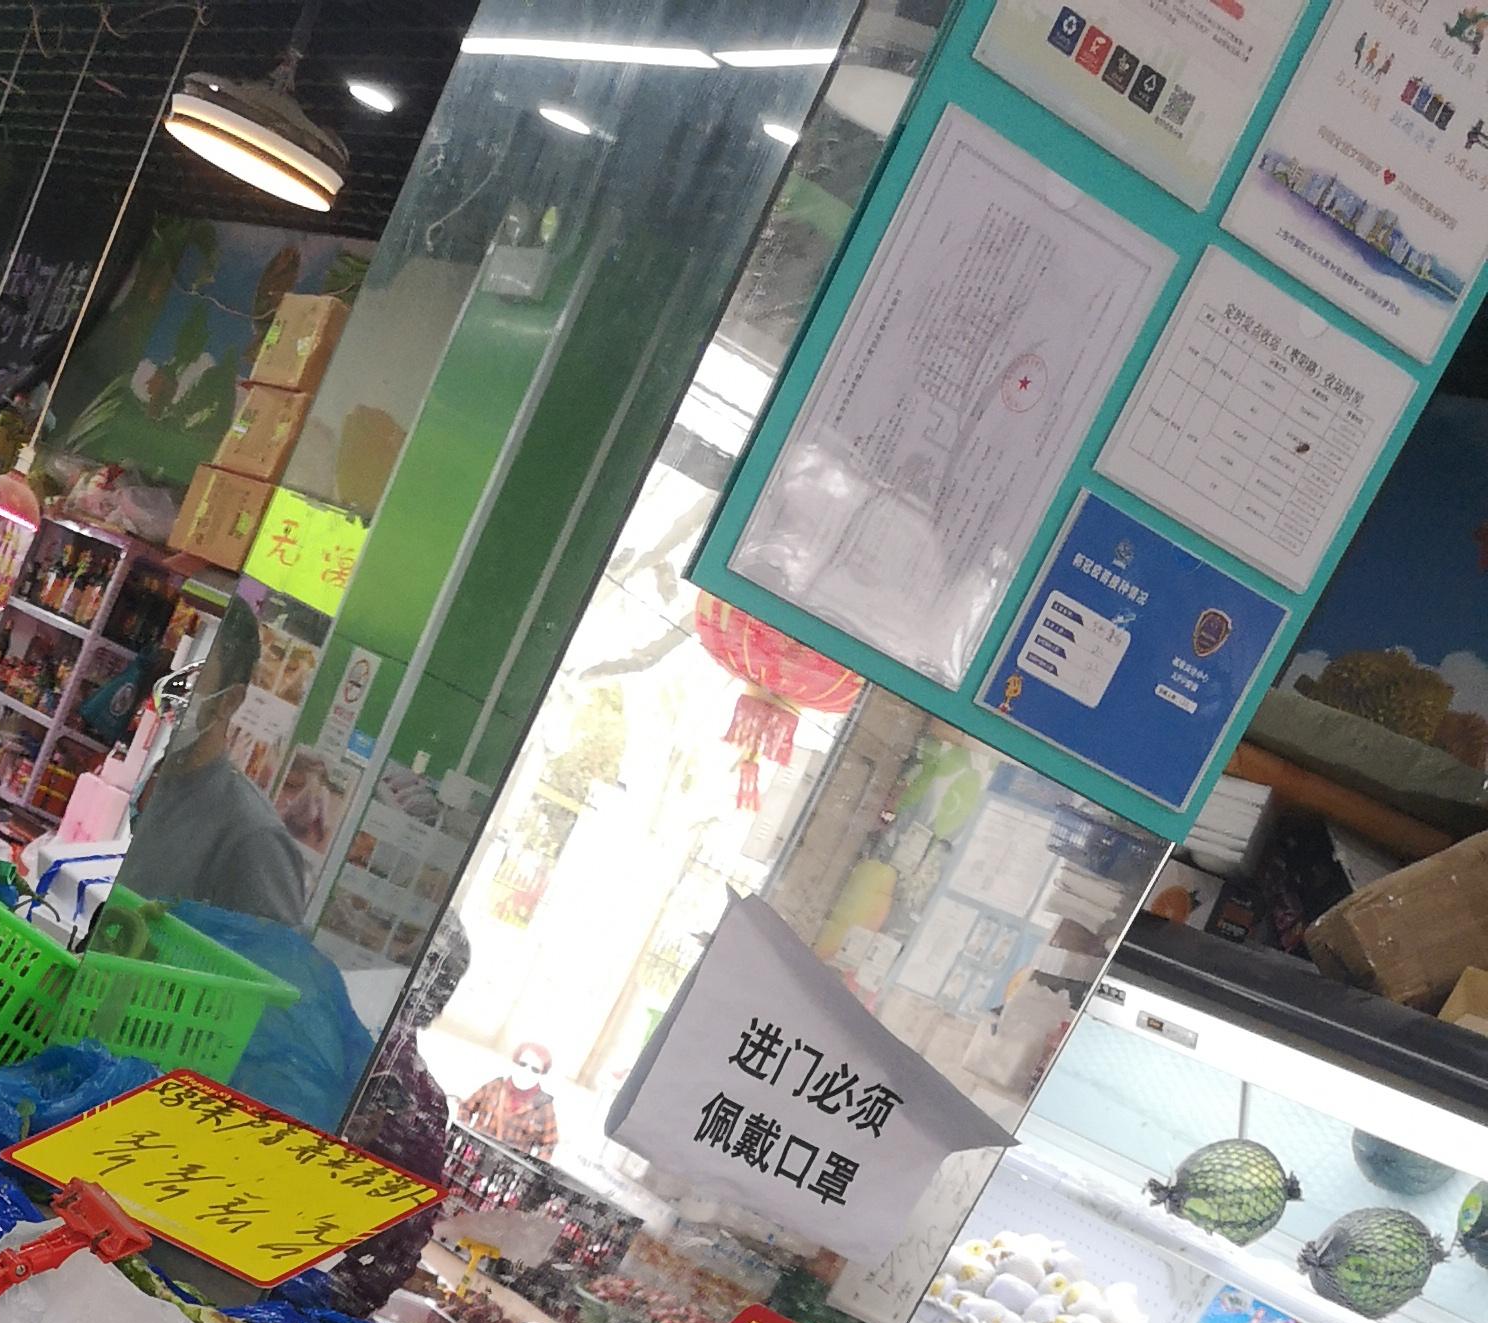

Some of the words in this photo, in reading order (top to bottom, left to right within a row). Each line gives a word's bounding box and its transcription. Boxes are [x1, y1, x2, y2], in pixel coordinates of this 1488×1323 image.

[726, 1015, 906, 1140] 进门必须
[691, 1090, 860, 1208] 佩戴口罩
